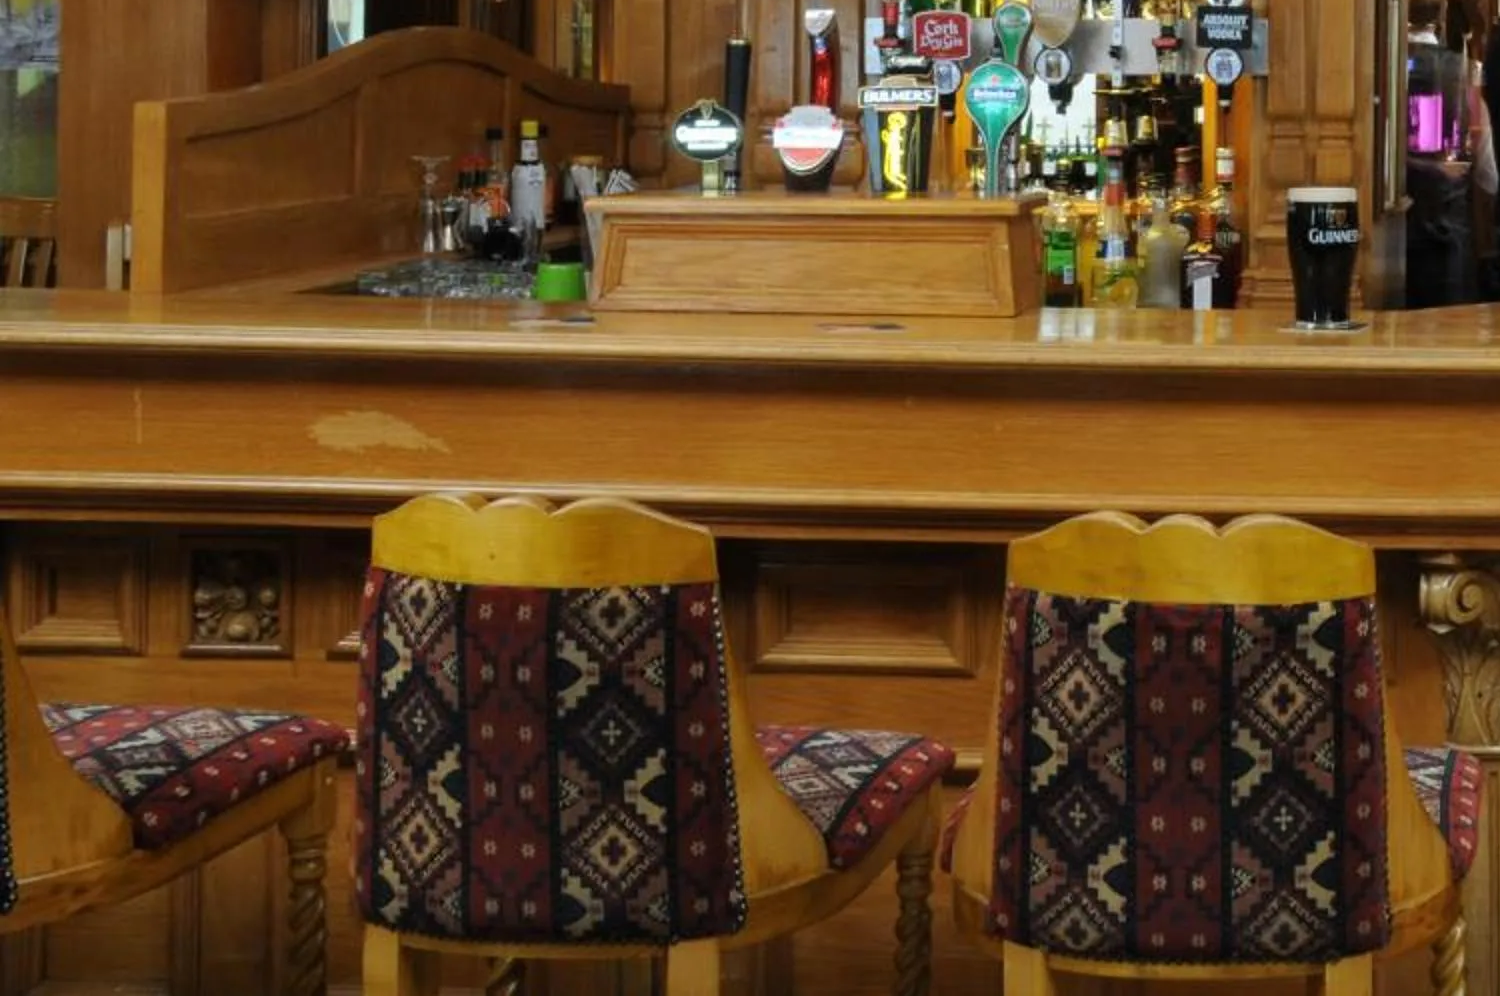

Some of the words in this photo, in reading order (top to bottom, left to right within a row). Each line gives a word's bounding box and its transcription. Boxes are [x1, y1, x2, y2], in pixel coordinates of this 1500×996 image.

[924, 18, 959, 36] Cork
[1203, 14, 1248, 29] ABSOLUT
[1207, 27, 1243, 40] VODKA
[863, 89, 933, 103] BULMERS
